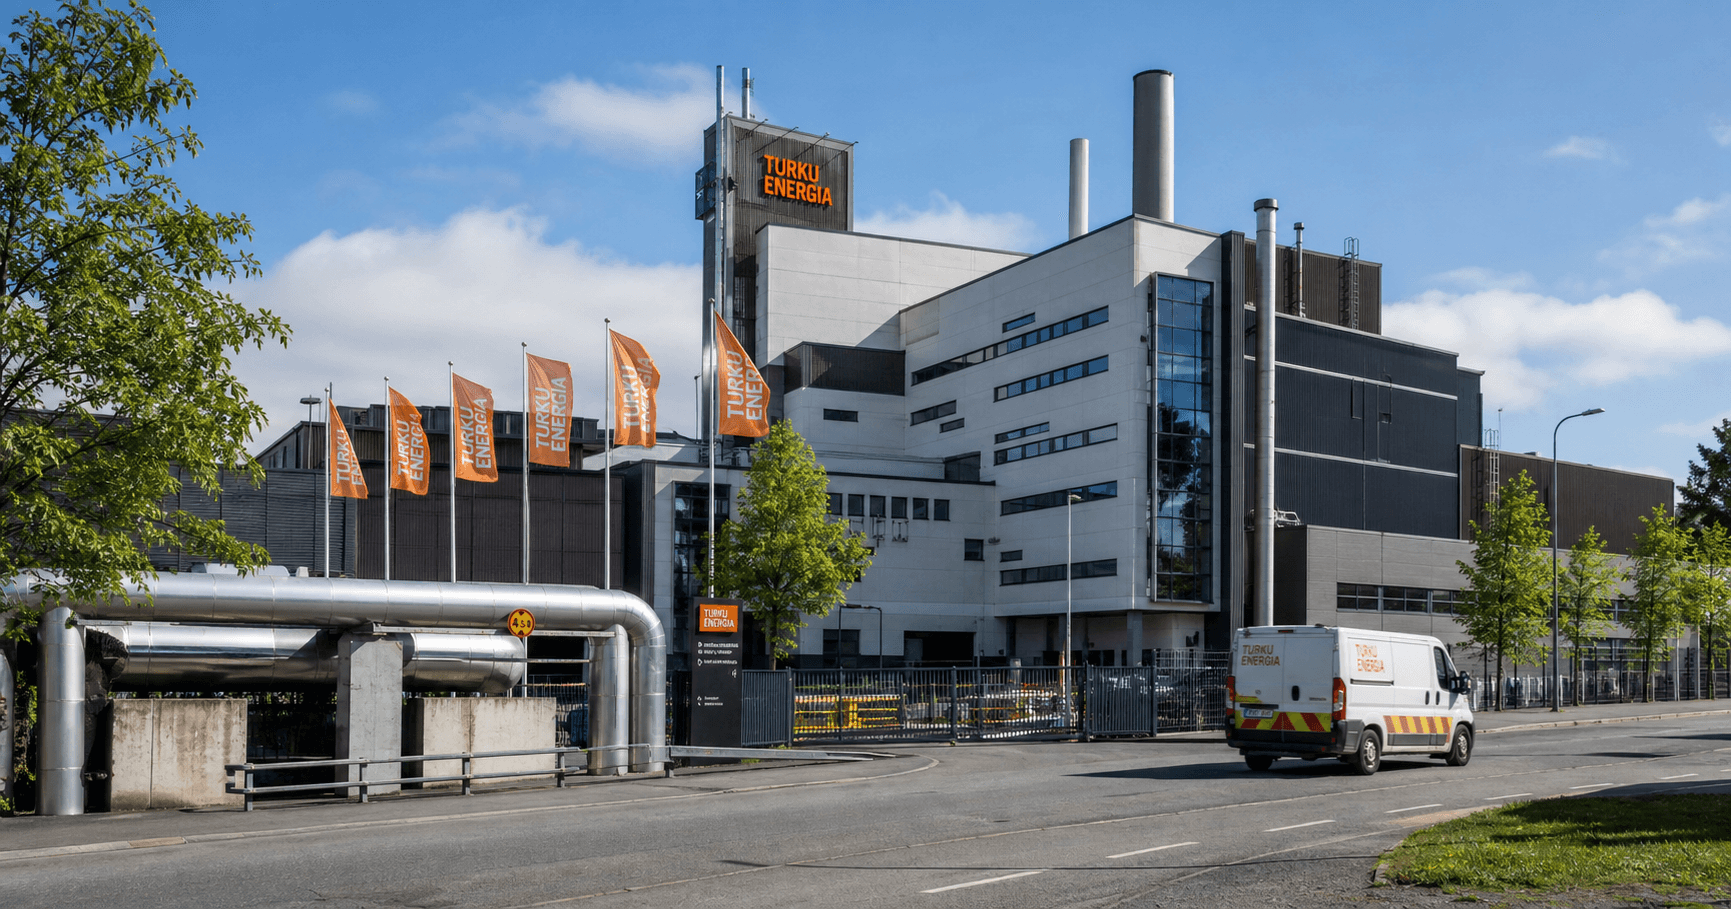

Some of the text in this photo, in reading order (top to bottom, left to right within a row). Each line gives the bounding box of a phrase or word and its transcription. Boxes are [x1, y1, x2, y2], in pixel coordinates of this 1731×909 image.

[763, 154, 820, 183] TURKU
[764, 174, 833, 206] ENERGIA
[621, 364, 640, 430] TURKU
[727, 350, 744, 418] TURKU
[460, 405, 474, 465] TURKU
[473, 398, 492, 469] ENERGIA
[535, 386, 551, 448] TURKU
[550, 377, 567, 452] ENERGIA
[336, 428, 351, 484] TURKU
[396, 419, 410, 476] TURKU
[1241, 655, 1281, 666] ENERGIA
[1242, 644, 1275, 655] TURKU
